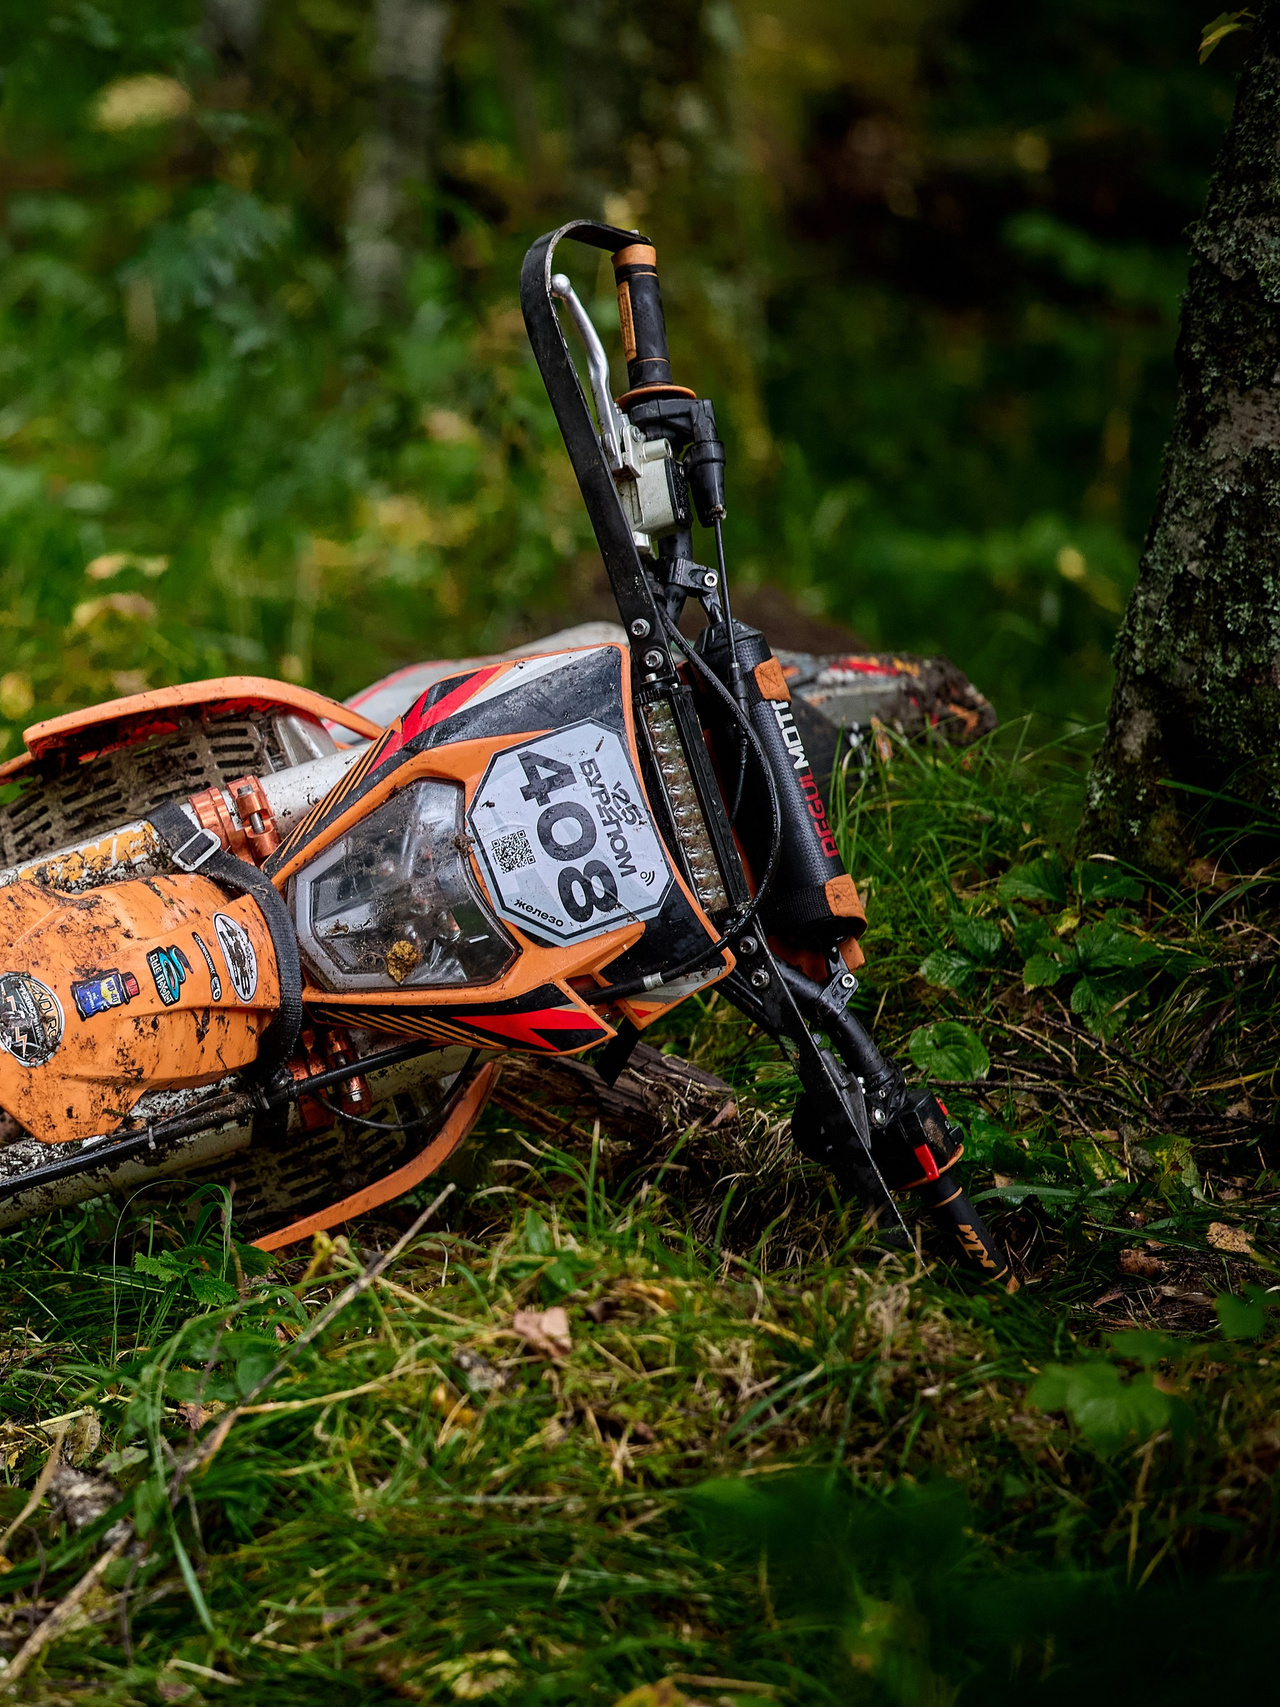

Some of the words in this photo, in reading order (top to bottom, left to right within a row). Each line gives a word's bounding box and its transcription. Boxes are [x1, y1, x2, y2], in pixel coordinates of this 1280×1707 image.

[516, 750, 620, 923] 408
[513, 899, 564, 927] железо
[106, 979, 120, 1003] WD-40
[956, 1224, 998, 1268] KTM
